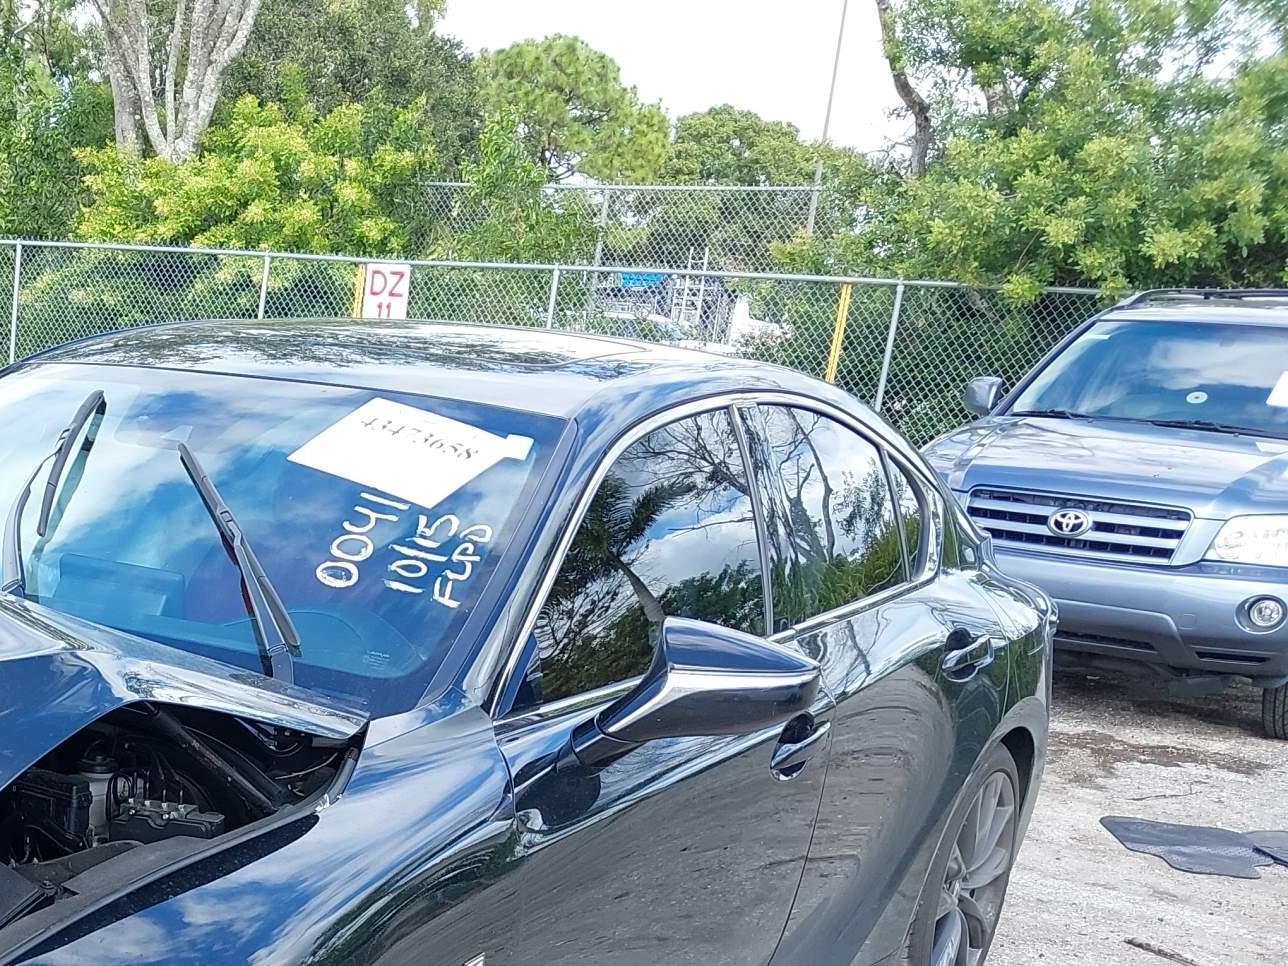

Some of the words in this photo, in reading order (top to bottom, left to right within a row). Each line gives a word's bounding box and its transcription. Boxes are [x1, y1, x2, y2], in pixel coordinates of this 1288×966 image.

[370, 269, 406, 297] DZ
[377, 301, 393, 320] 11
[315, 492, 411, 588] 0041
